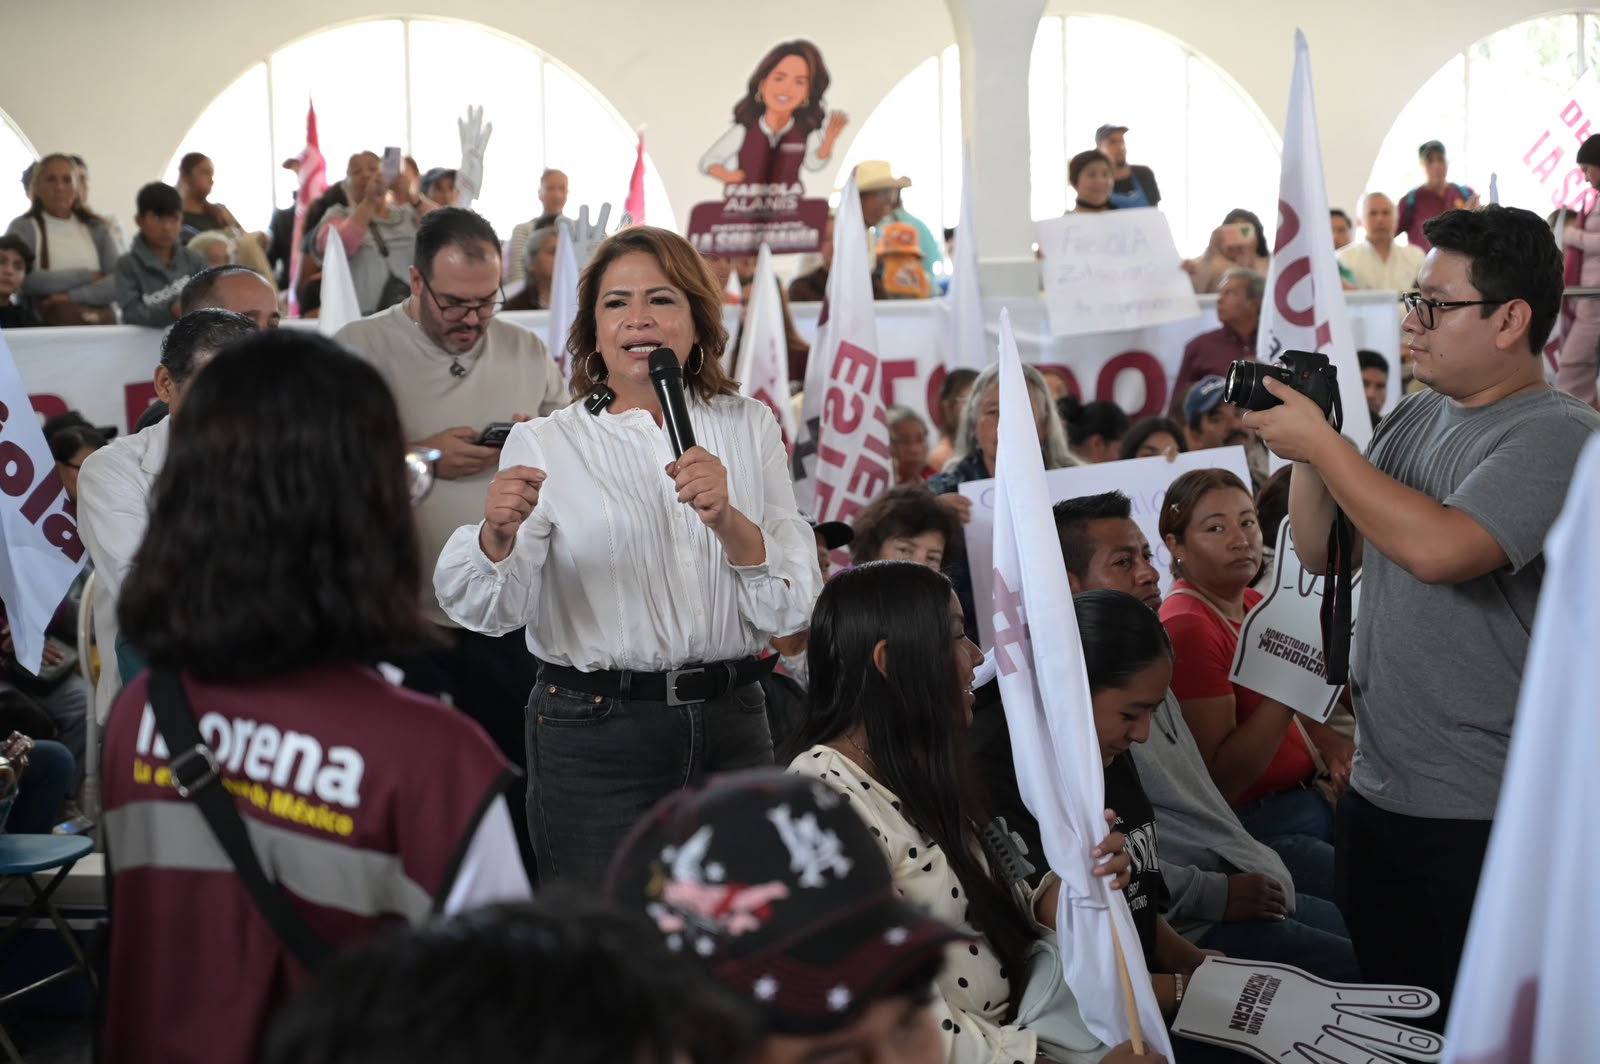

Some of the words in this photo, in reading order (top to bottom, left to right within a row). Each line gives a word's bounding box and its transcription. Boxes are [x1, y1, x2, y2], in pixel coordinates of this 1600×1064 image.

[1264, 627, 1310, 654] HONESTIDAD
[1310, 647, 1318, 657] Y
[269, 788, 354, 837] México
[1246, 1011, 1266, 1036] AMOR
